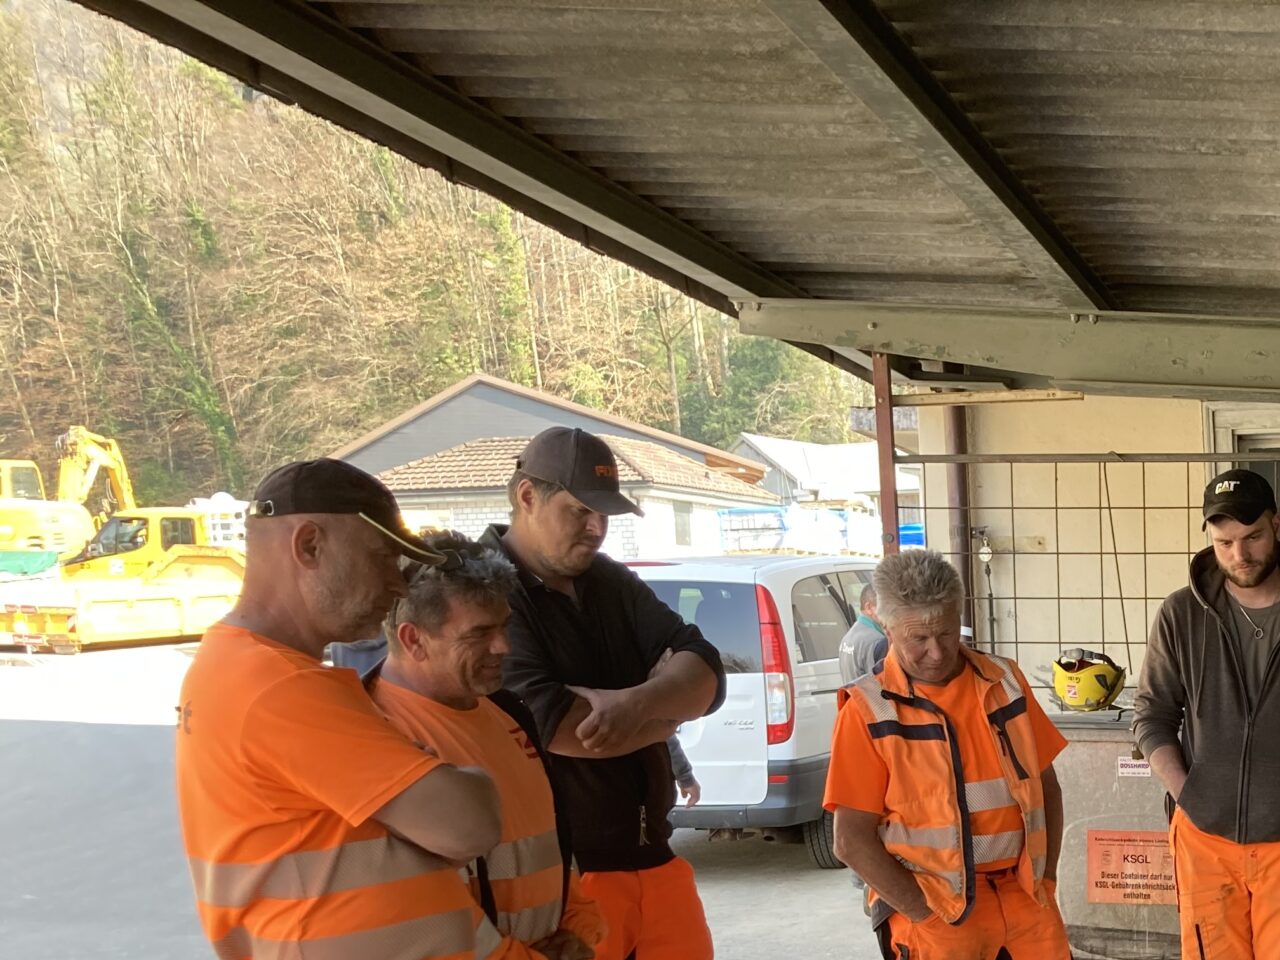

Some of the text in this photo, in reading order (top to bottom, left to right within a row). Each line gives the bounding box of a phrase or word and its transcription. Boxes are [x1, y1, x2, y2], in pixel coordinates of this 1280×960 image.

[1215, 481, 1236, 494] CAT
[1123, 855, 1151, 863] KSGL
[1121, 872, 1148, 880] Container
